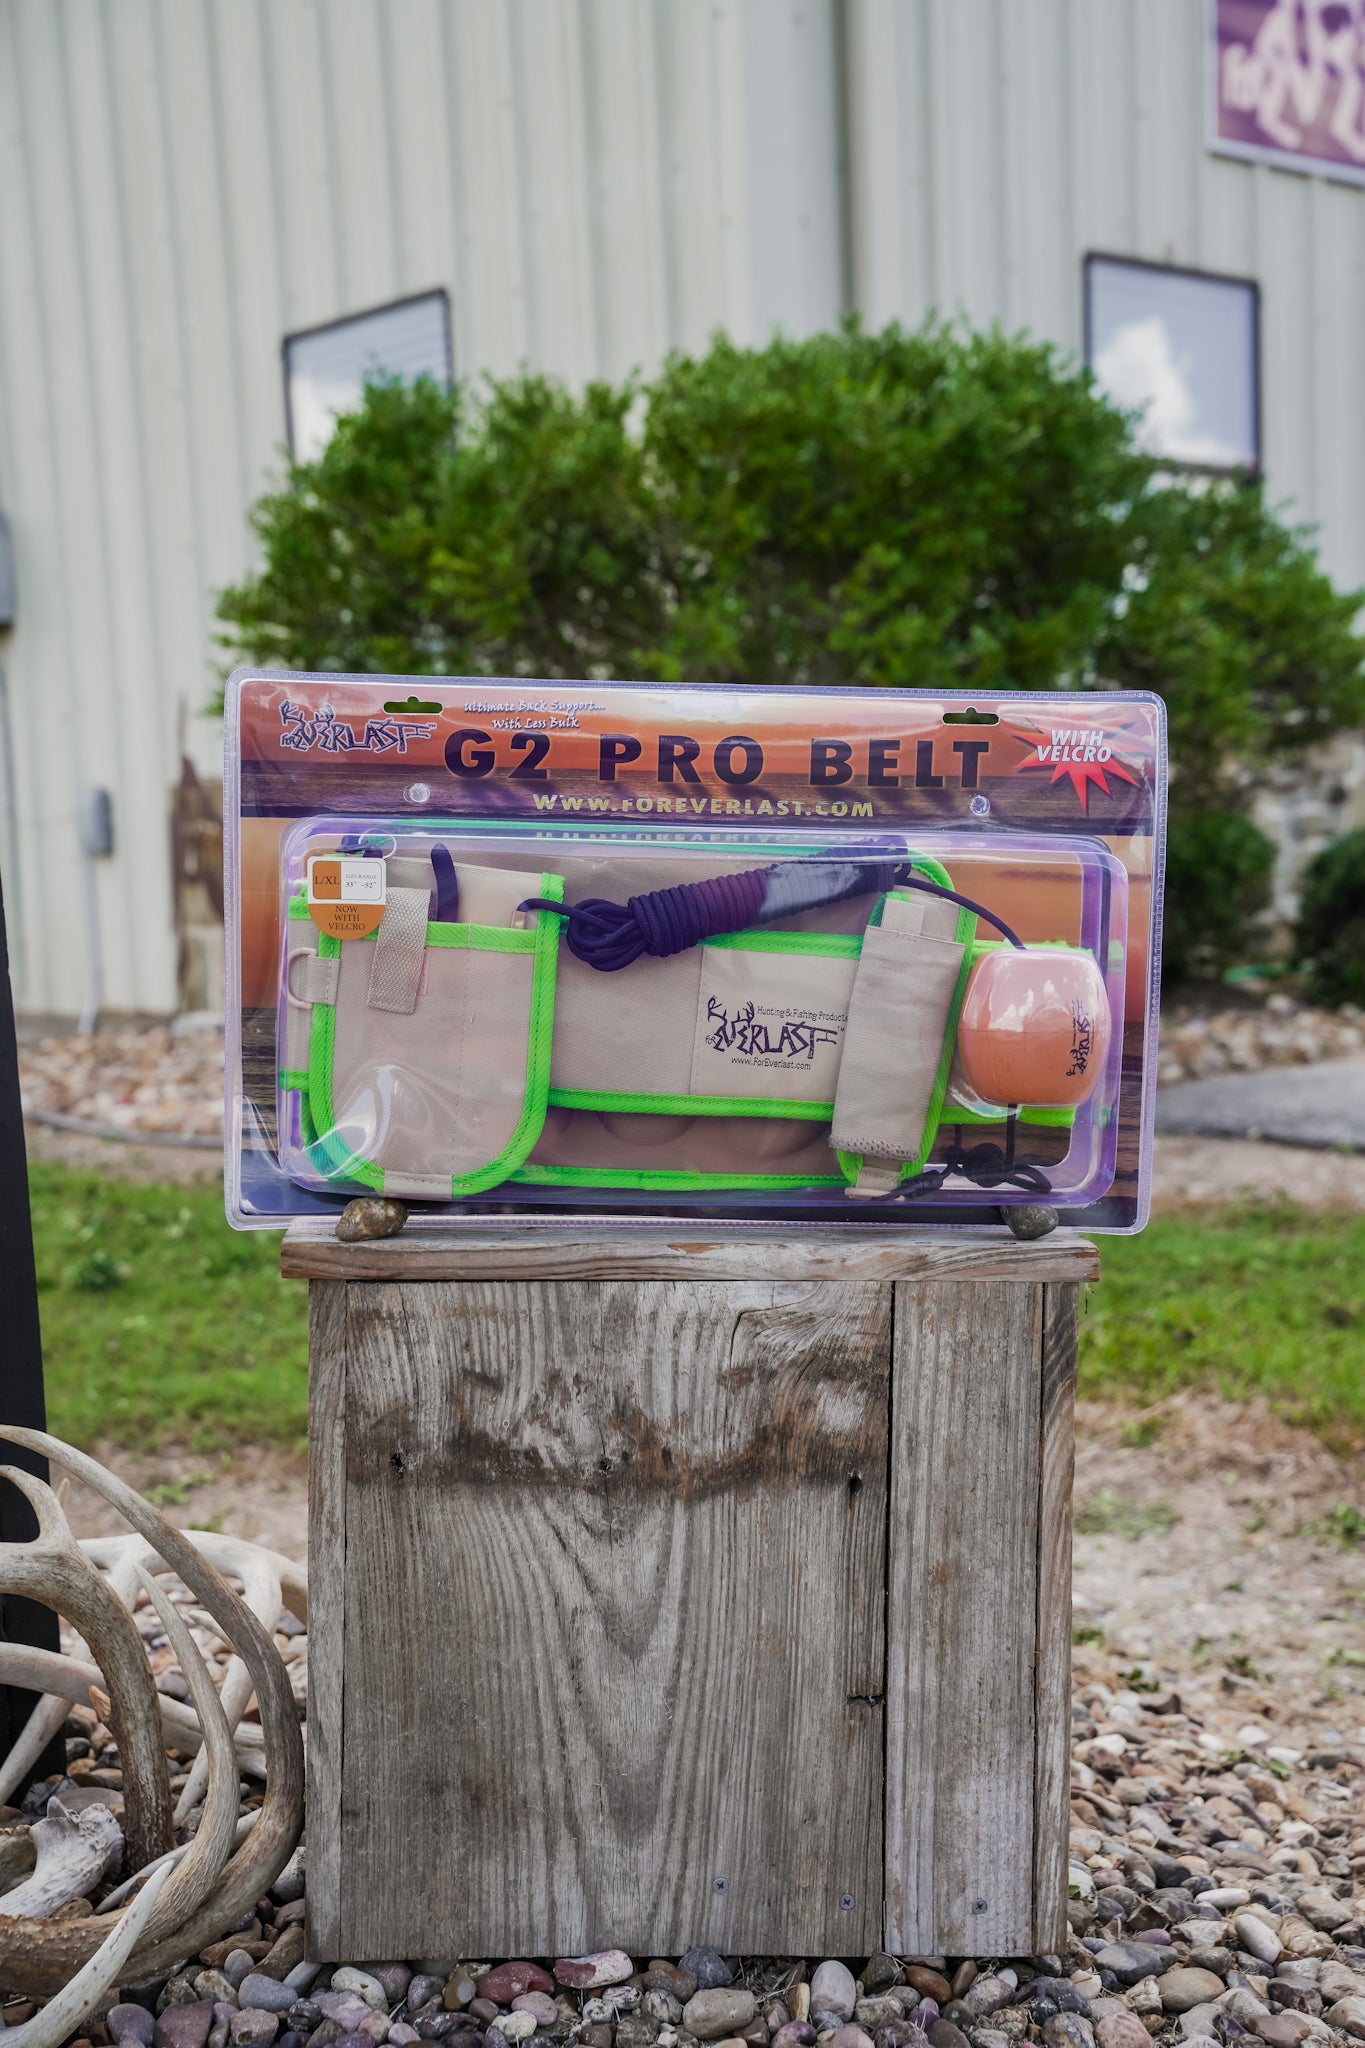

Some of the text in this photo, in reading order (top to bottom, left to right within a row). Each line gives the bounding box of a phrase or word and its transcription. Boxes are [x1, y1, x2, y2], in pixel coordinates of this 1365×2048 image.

[464, 702, 515, 713] Ultimate
[518, 701, 547, 712] Back
[492, 717, 580, 729] With Less Bulk
[1050, 729, 1104, 747] WITH
[444, 729, 990, 787] G2 PRO BELT
[1036, 745, 1112, 763] VELCRO
[532, 793, 874, 817] WWW.FOREVERLAST.COM
[315, 875, 340, 885] L/XL
[335, 905, 359, 913] NOW
[334, 914, 360, 922] WITH
[328, 922, 366, 931] VELCRO
[757, 1006, 785, 1018] Hunting
[793, 1008, 817, 1021] Fishing
